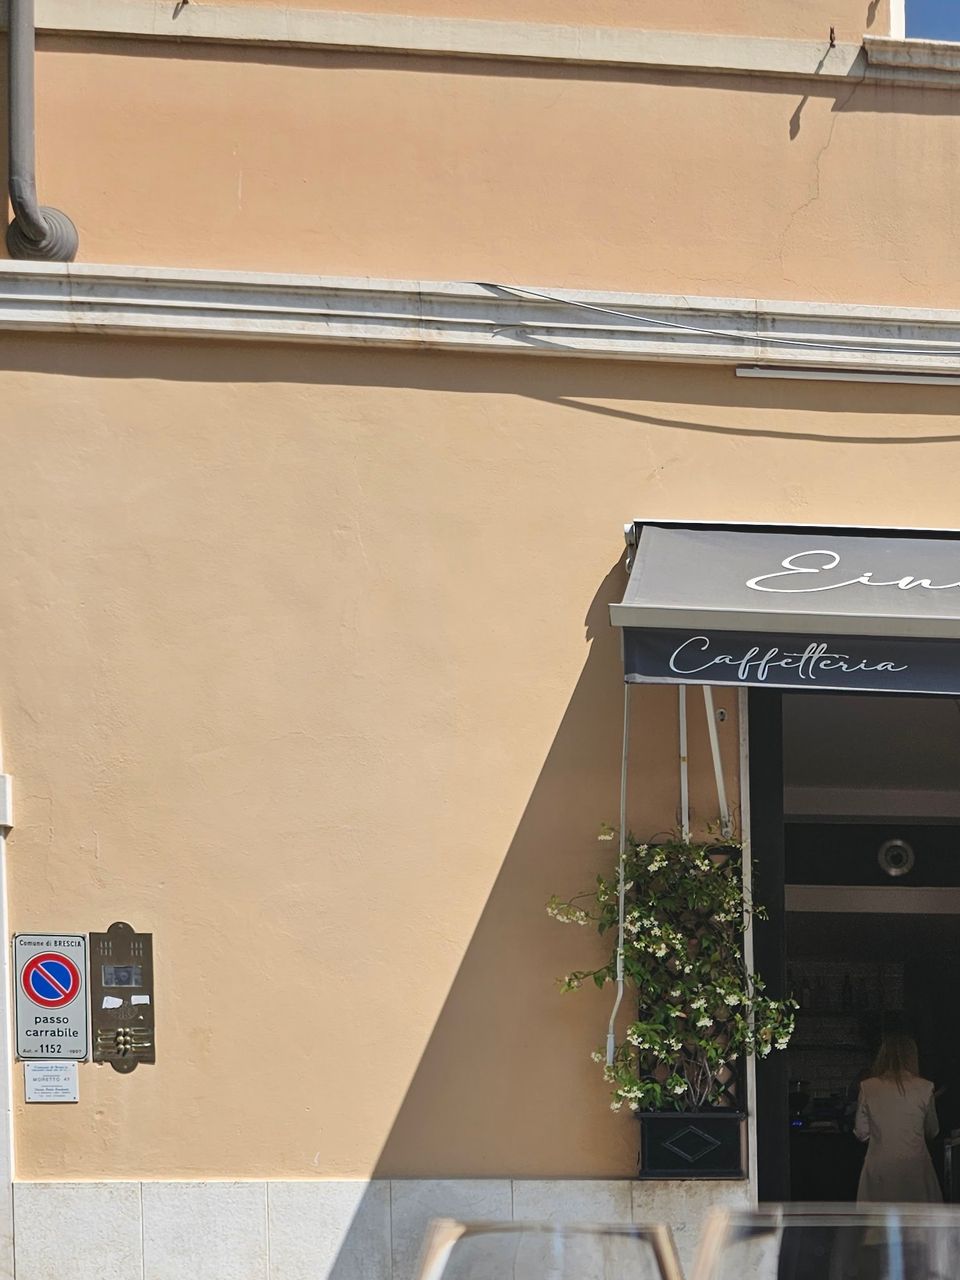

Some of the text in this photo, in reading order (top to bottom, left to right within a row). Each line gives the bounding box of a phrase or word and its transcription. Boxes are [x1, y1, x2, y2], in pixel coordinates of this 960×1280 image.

[669, 636, 908, 680] Caffetteria
[34, 1016, 69, 1025] passo
[25, 1028, 79, 1037] carrabile
[40, 1044, 62, 1053] 1152
